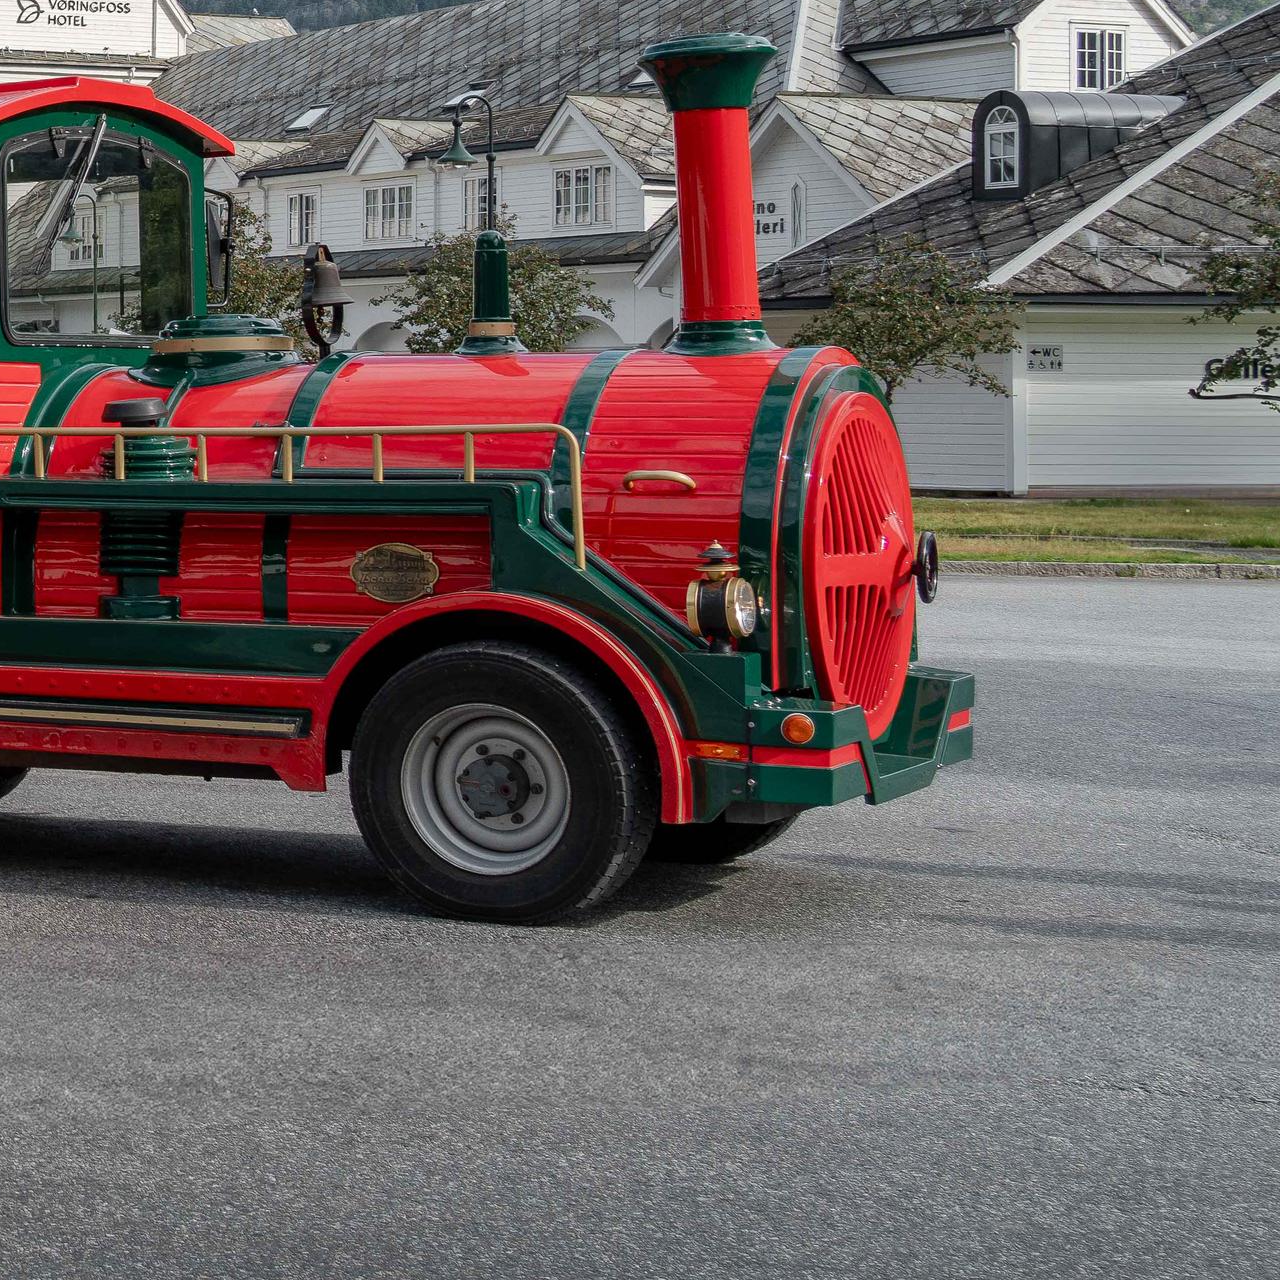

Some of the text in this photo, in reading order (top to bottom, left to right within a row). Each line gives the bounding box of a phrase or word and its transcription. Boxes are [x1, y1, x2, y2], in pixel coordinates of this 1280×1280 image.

[48, 0, 131, 14] VØRINGFOSS
[47, 14, 88, 27] HOTEL
[1042, 347, 1060, 357] WC
